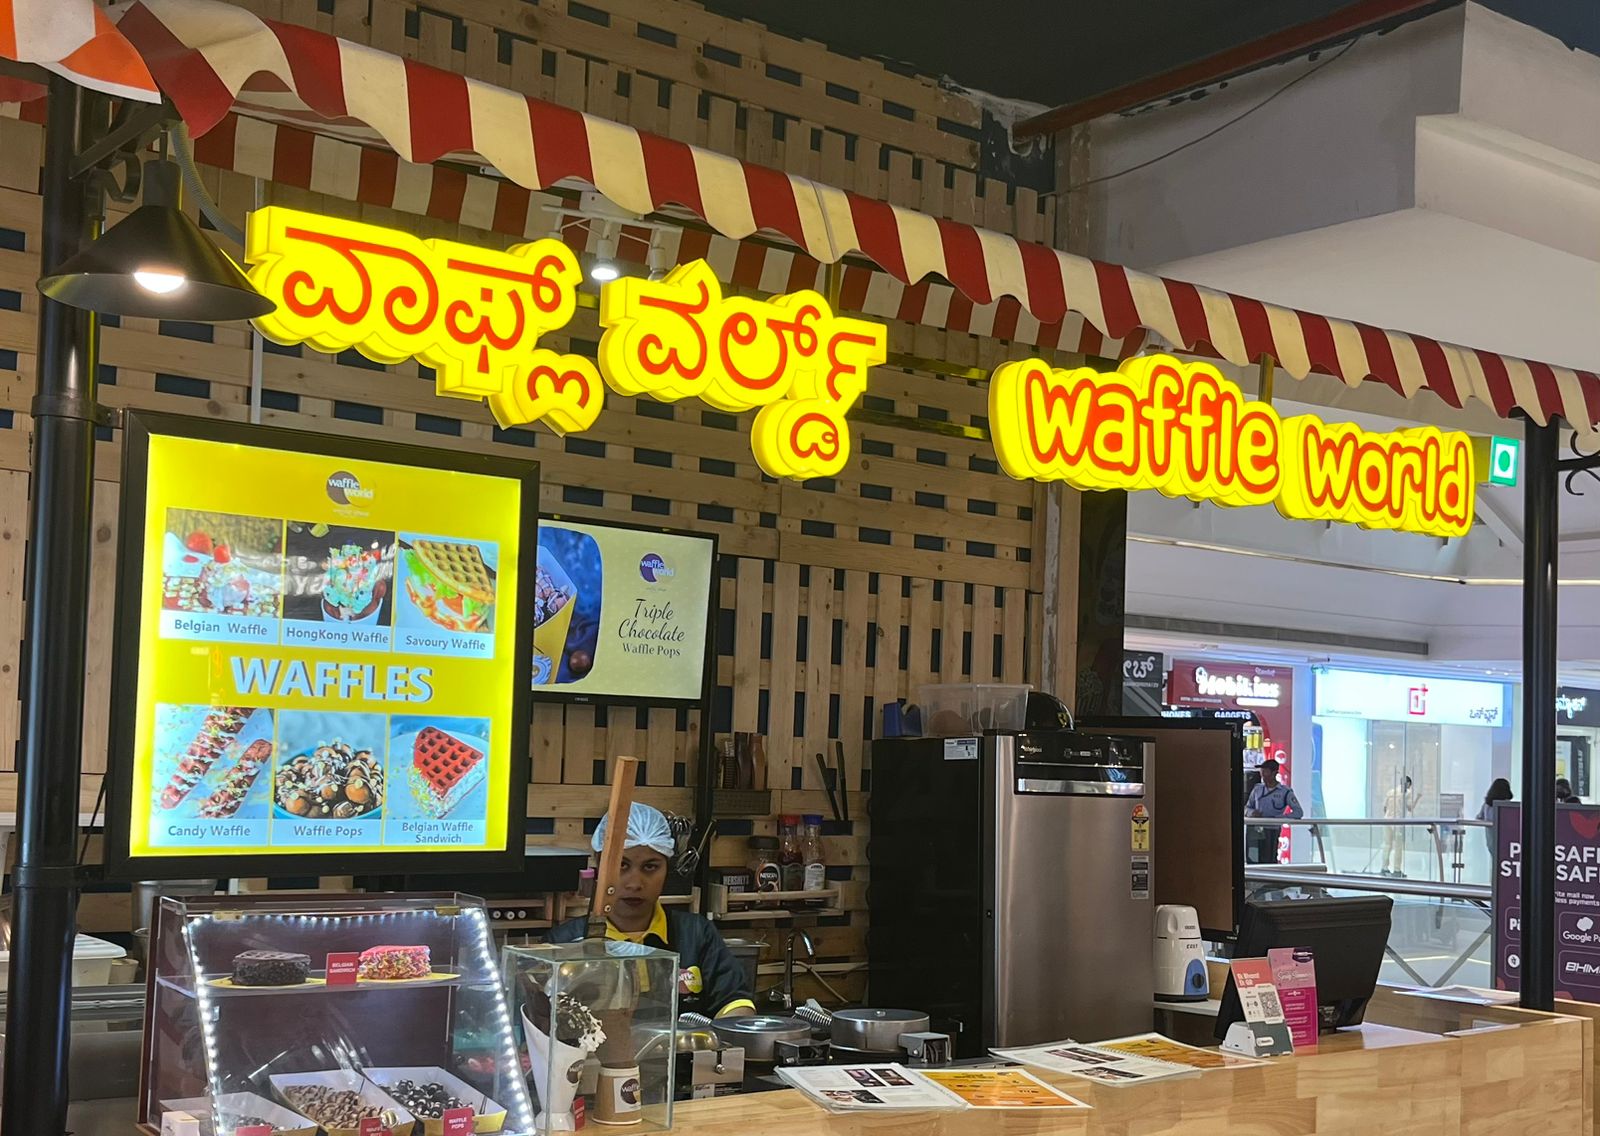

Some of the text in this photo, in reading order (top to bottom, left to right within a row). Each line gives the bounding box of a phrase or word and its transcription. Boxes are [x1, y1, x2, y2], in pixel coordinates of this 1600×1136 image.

[1024, 363, 1470, 527] waffle world
[641, 559, 665, 569] waffle
[634, 598, 675, 624] Triple
[174, 618, 268, 637] Belgian Waffle
[286, 626, 389, 645] HongKong Waffle
[618, 618, 686, 643] Chocolate
[405, 635, 486, 651] Savoury Waffle
[622, 642, 681, 659] Waffle Pops
[229, 655, 433, 703] WAFFLES
[168, 824, 251, 838] Candy Waffle
[294, 825, 363, 838] Waffle Pops
[402, 821, 474, 833] Belgian Waffle
[415, 832, 462, 843] Sandwich
[1556, 864, 1600, 883] SAF
[1562, 930, 1592, 943] Google
